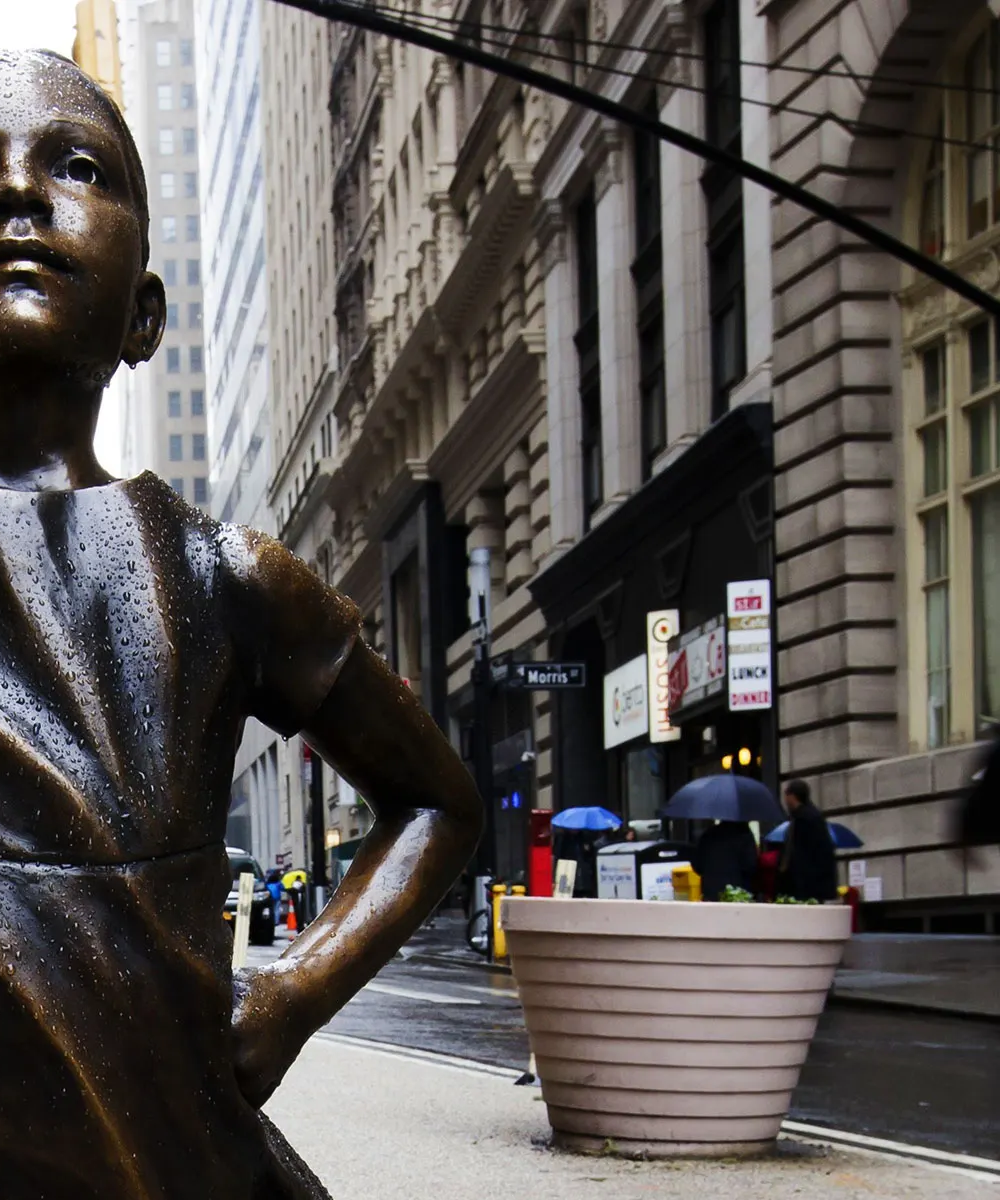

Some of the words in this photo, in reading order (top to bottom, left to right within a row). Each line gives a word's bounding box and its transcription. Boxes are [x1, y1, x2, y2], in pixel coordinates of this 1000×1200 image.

[528, 670, 568, 684] Morris
[732, 666, 768, 680] LUNCH
[732, 691, 769, 705] DINNER
